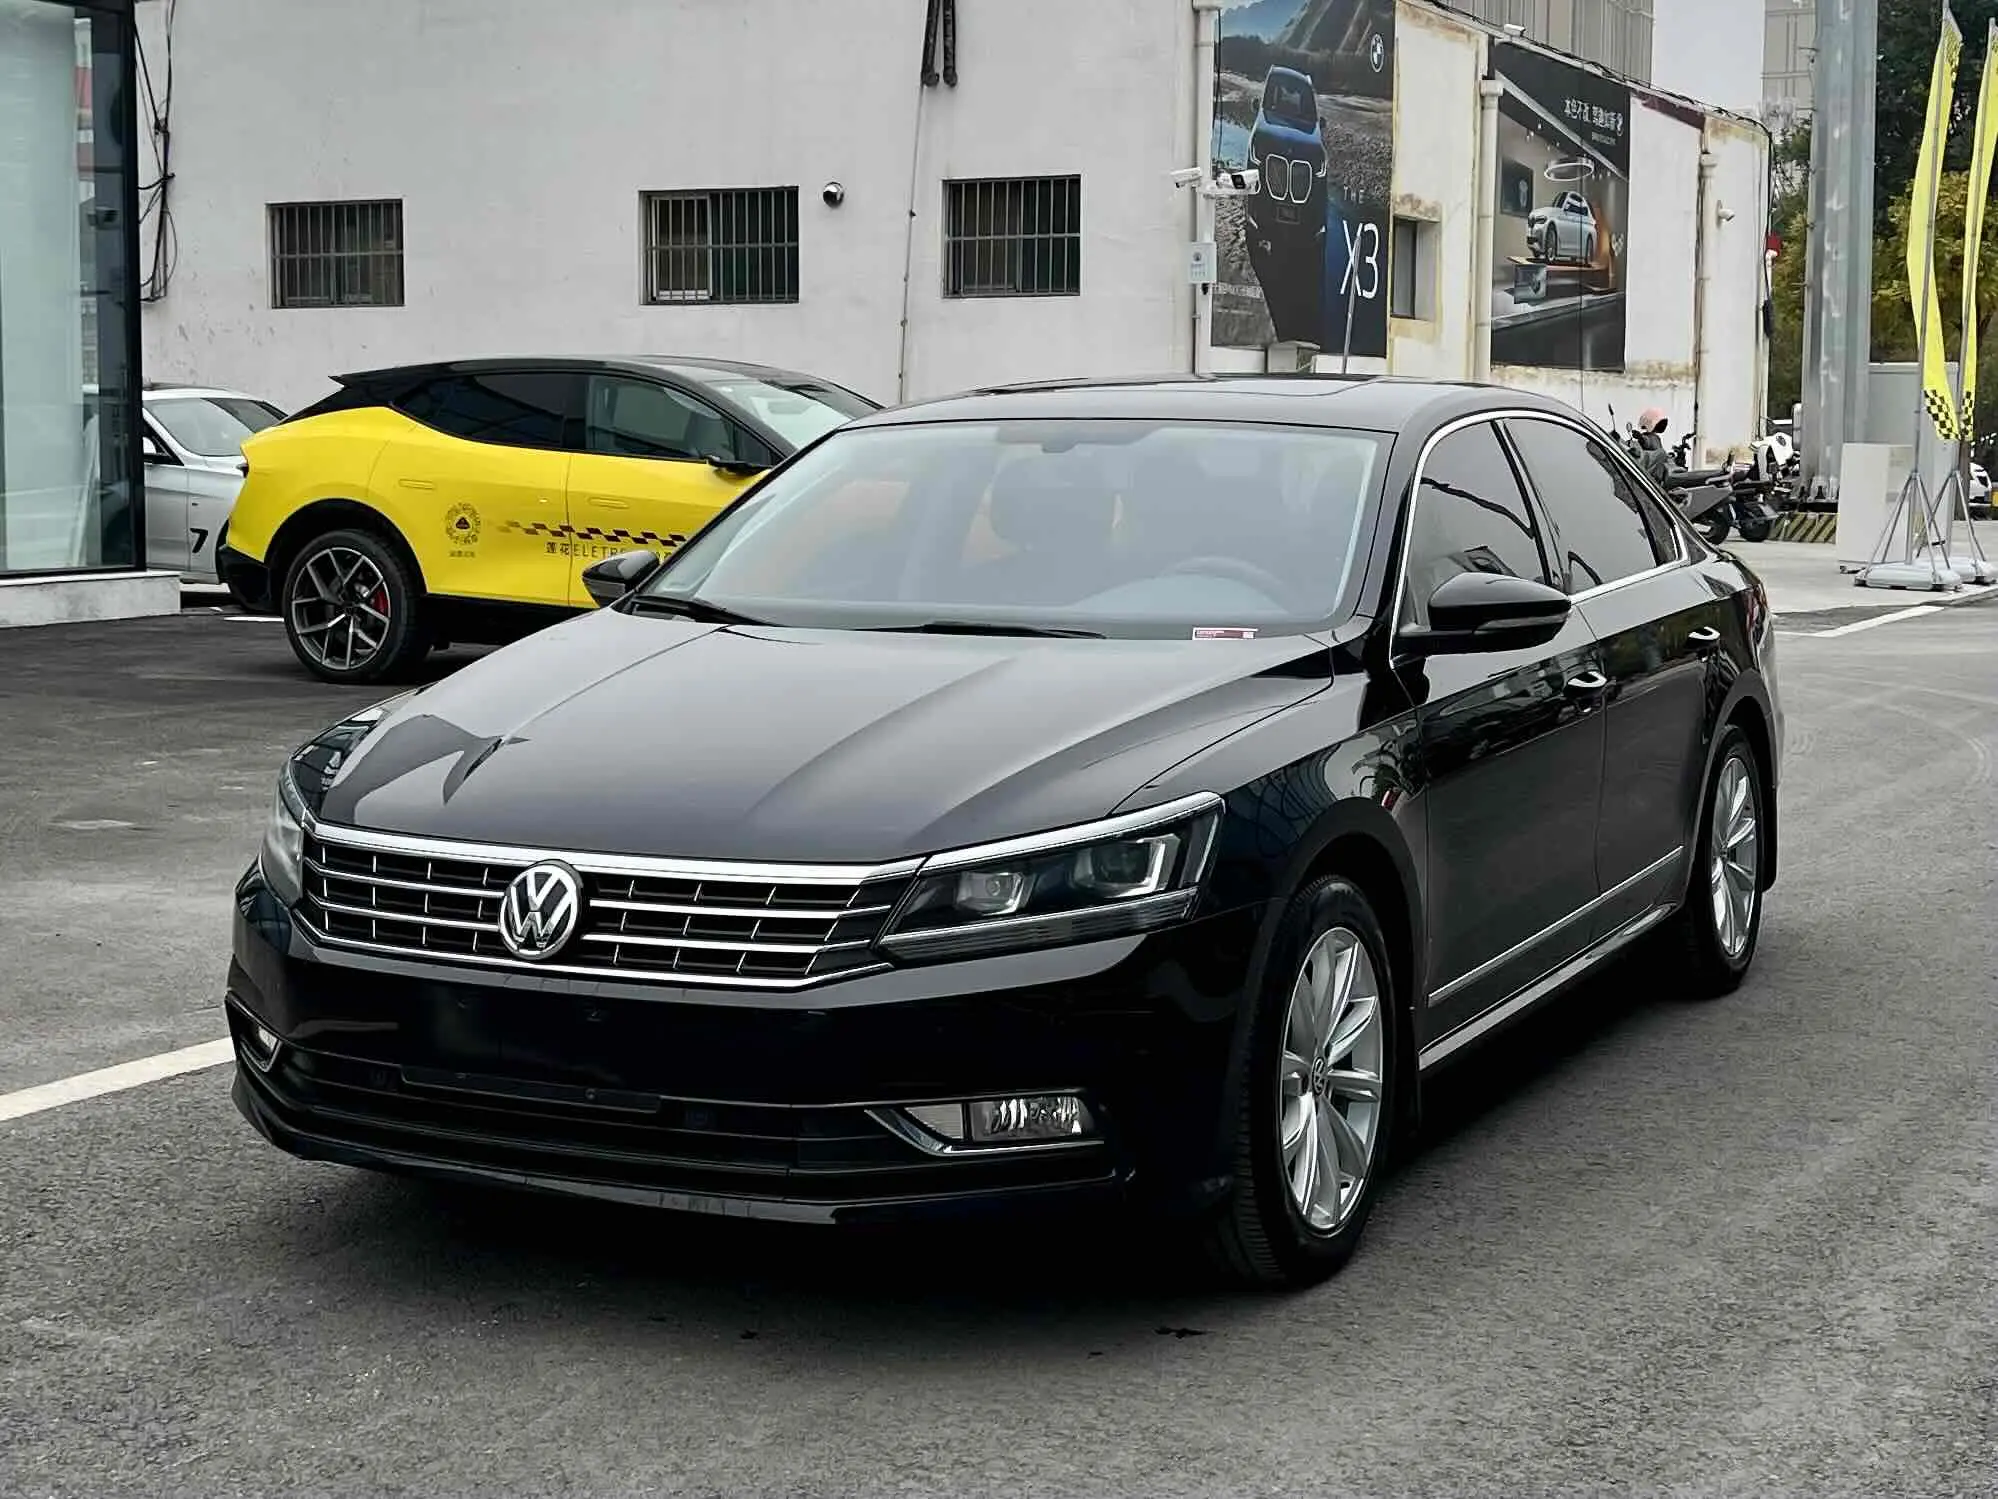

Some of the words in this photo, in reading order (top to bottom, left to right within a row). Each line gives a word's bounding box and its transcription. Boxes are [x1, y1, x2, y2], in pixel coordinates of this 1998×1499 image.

[1340, 219, 1380, 300] X3
[190, 527, 209, 554] 7
[503, 865, 575, 952] VW
